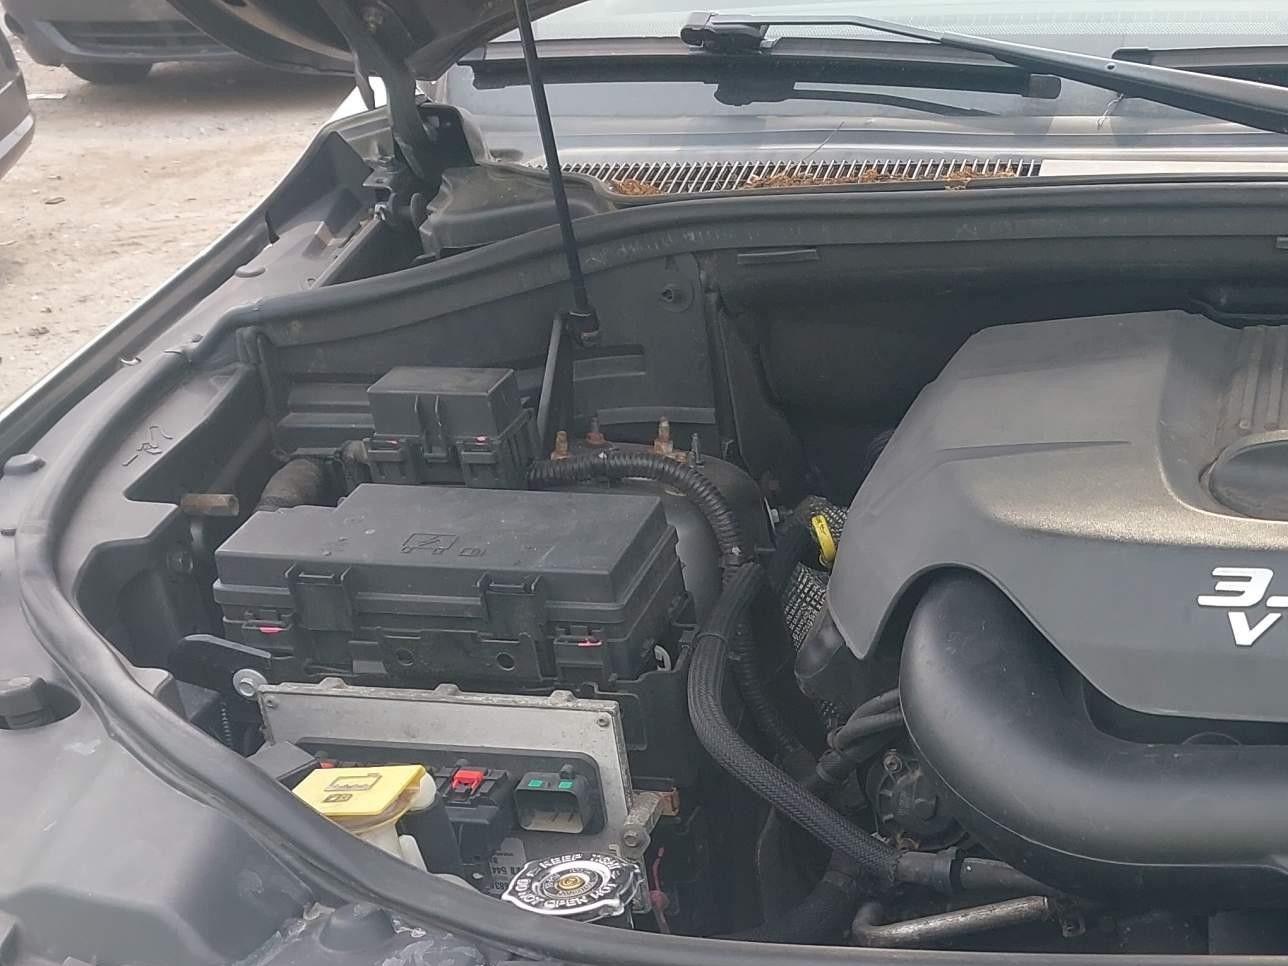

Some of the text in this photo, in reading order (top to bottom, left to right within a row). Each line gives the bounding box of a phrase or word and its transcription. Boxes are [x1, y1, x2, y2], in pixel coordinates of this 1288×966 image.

[539, 853, 583, 869] KEEP
[518, 891, 545, 906] NOT
[544, 896, 588, 909] OPEN
[590, 884, 617, 900] HOT
